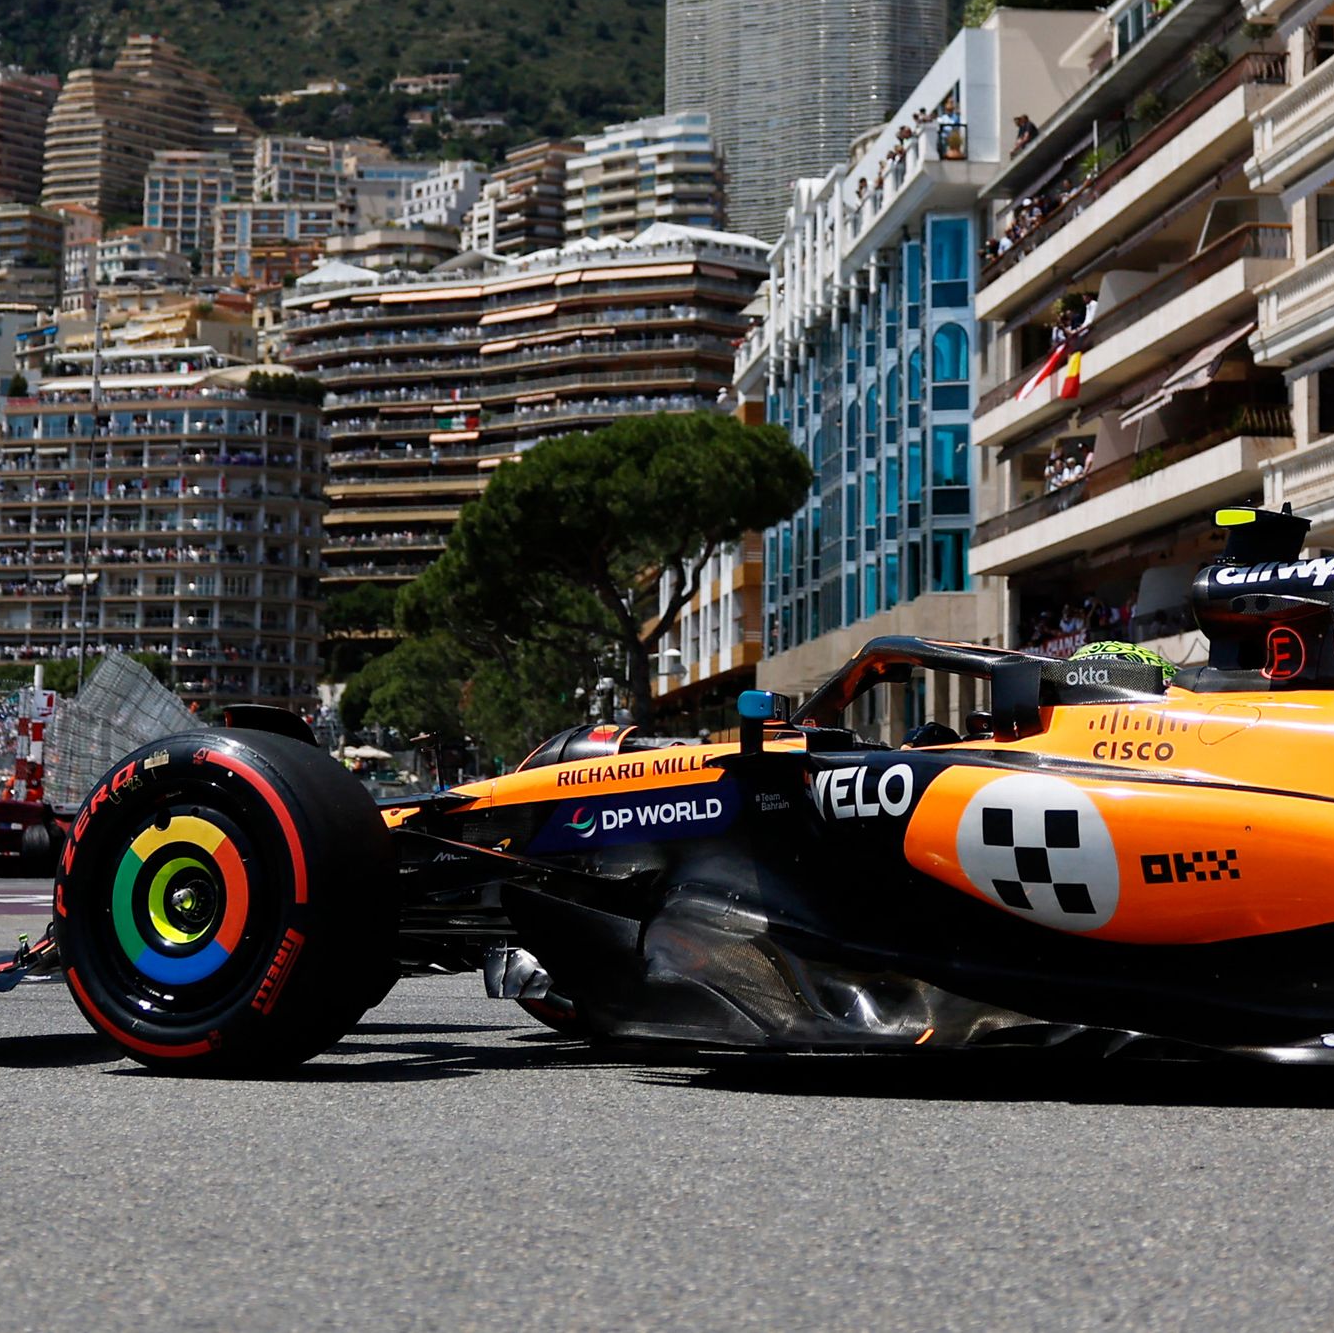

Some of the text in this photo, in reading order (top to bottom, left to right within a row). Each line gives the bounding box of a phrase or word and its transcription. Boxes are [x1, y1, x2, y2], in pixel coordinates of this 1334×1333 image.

[1066, 666, 1110, 686] okta
[1092, 741, 1175, 762] CISCO
[557, 762, 645, 787] RICHARD
[810, 762, 915, 820] VELO
[62, 760, 138, 876] ZERO
[601, 798, 723, 831] DP WORLD
[1140, 849, 1241, 884] OKX
[251, 928, 305, 1015] PIRELLI
